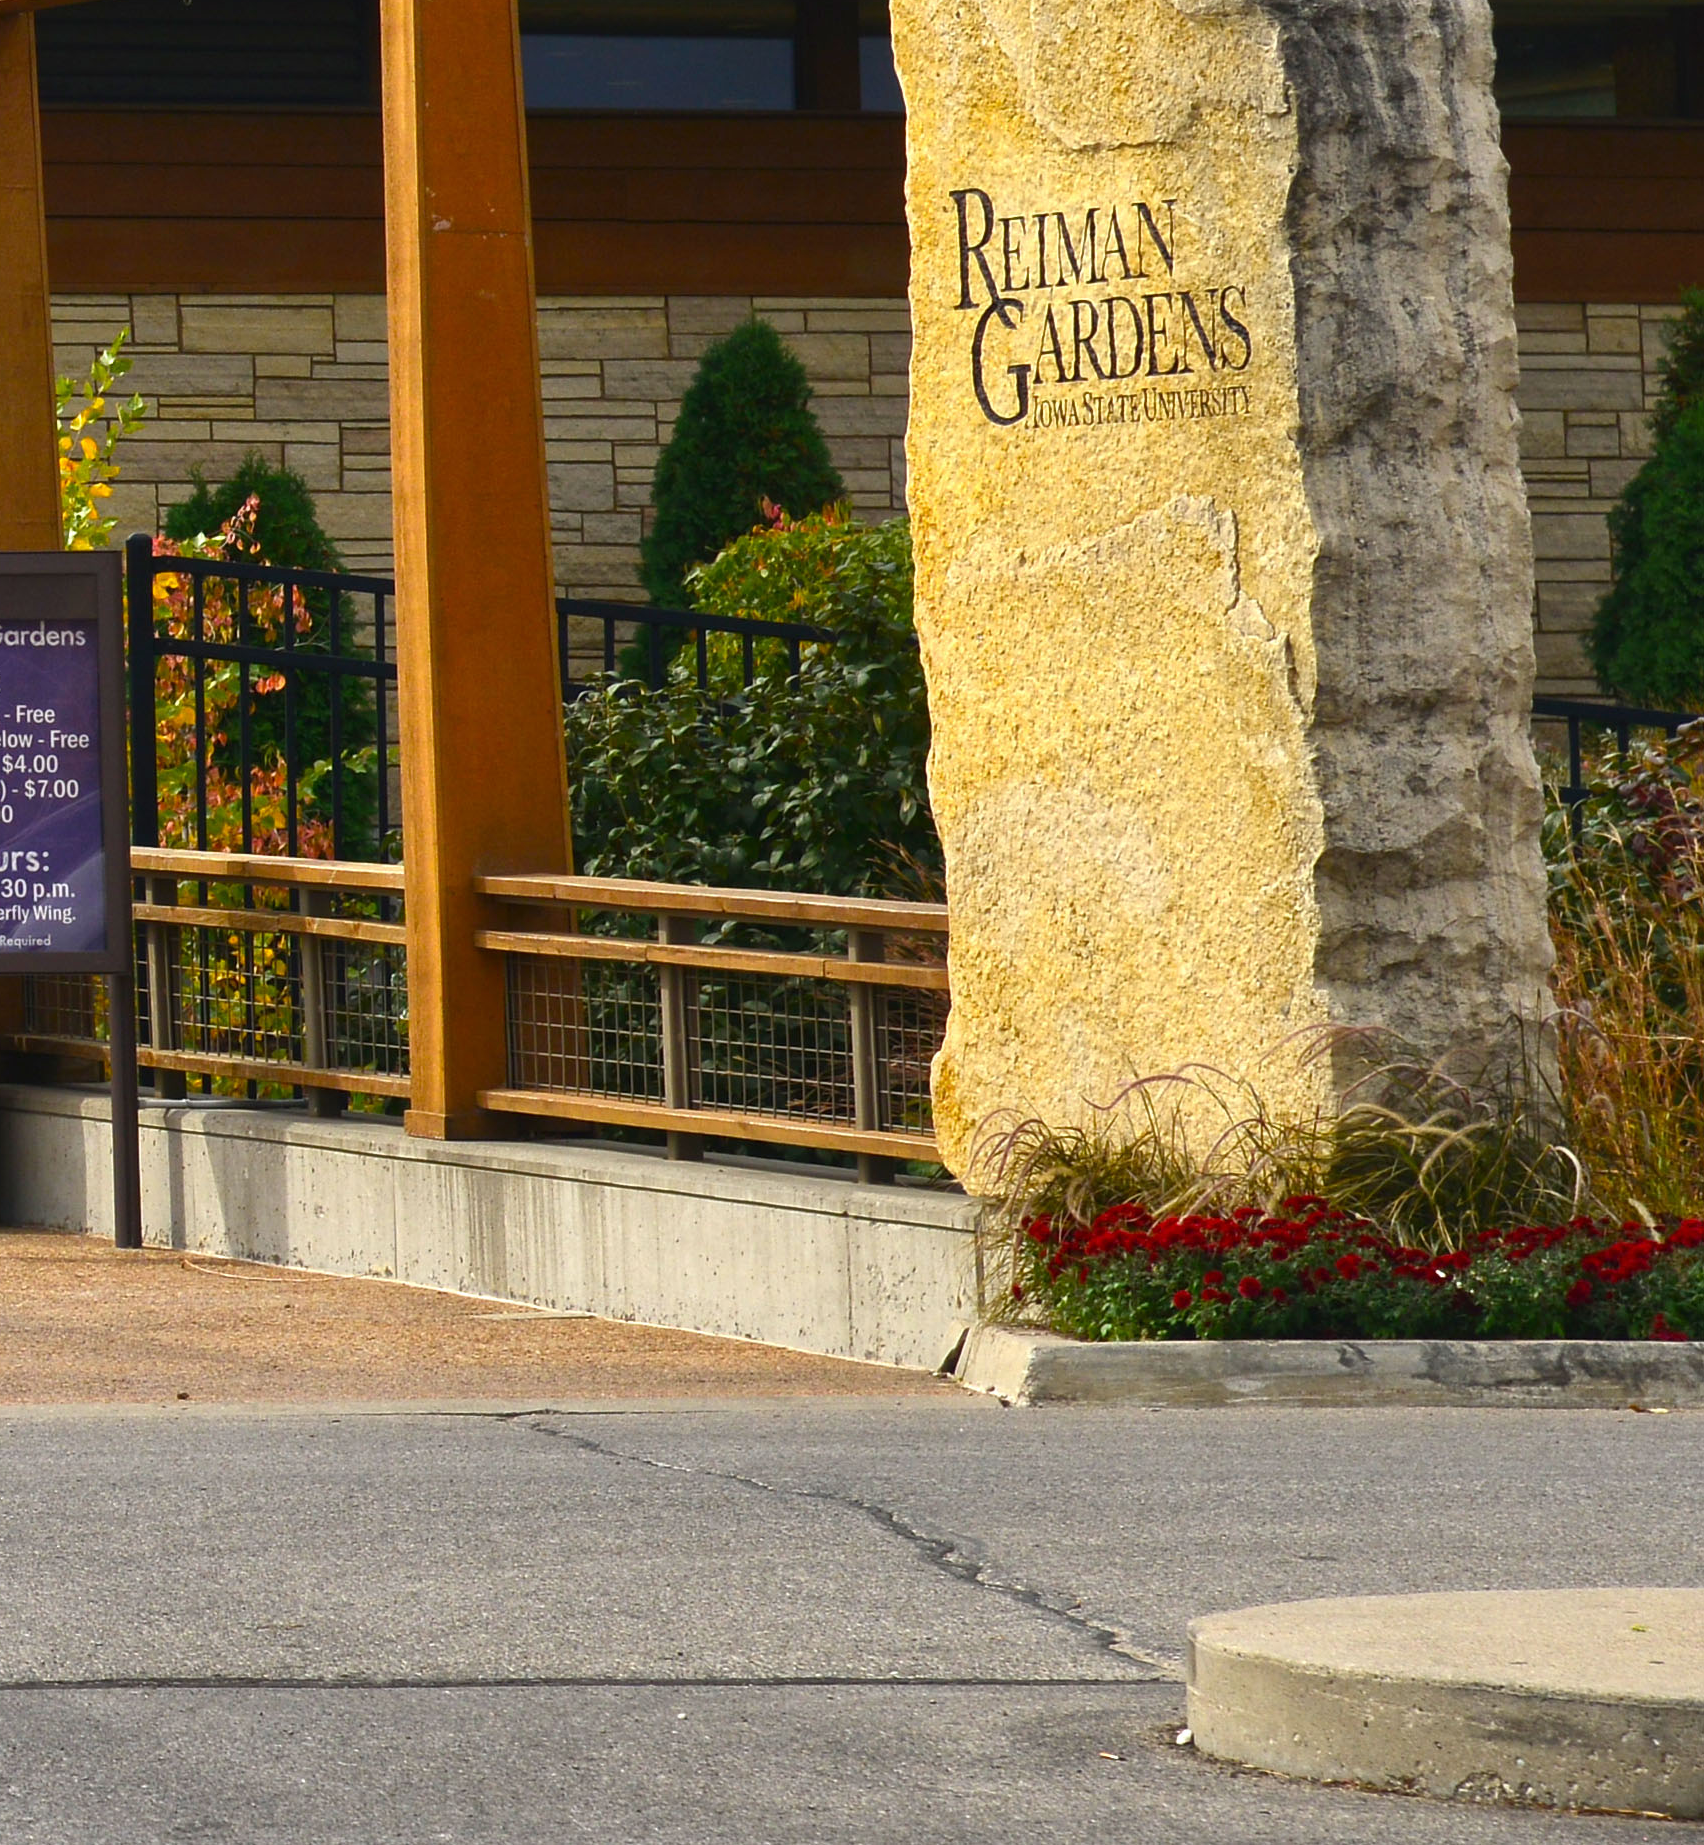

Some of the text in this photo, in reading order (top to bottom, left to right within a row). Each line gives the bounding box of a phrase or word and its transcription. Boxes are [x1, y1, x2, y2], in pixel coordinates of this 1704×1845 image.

[16, 704, 56, 724] Free
[50, 729, 90, 749] Free
[2, 753, 59, 775] $4.00
[24, 779, 79, 800] $7.00
[32, 882, 76, 903] p.m.
[32, 904, 77, 925] Wing.
[0, 934, 52, 949] Required
